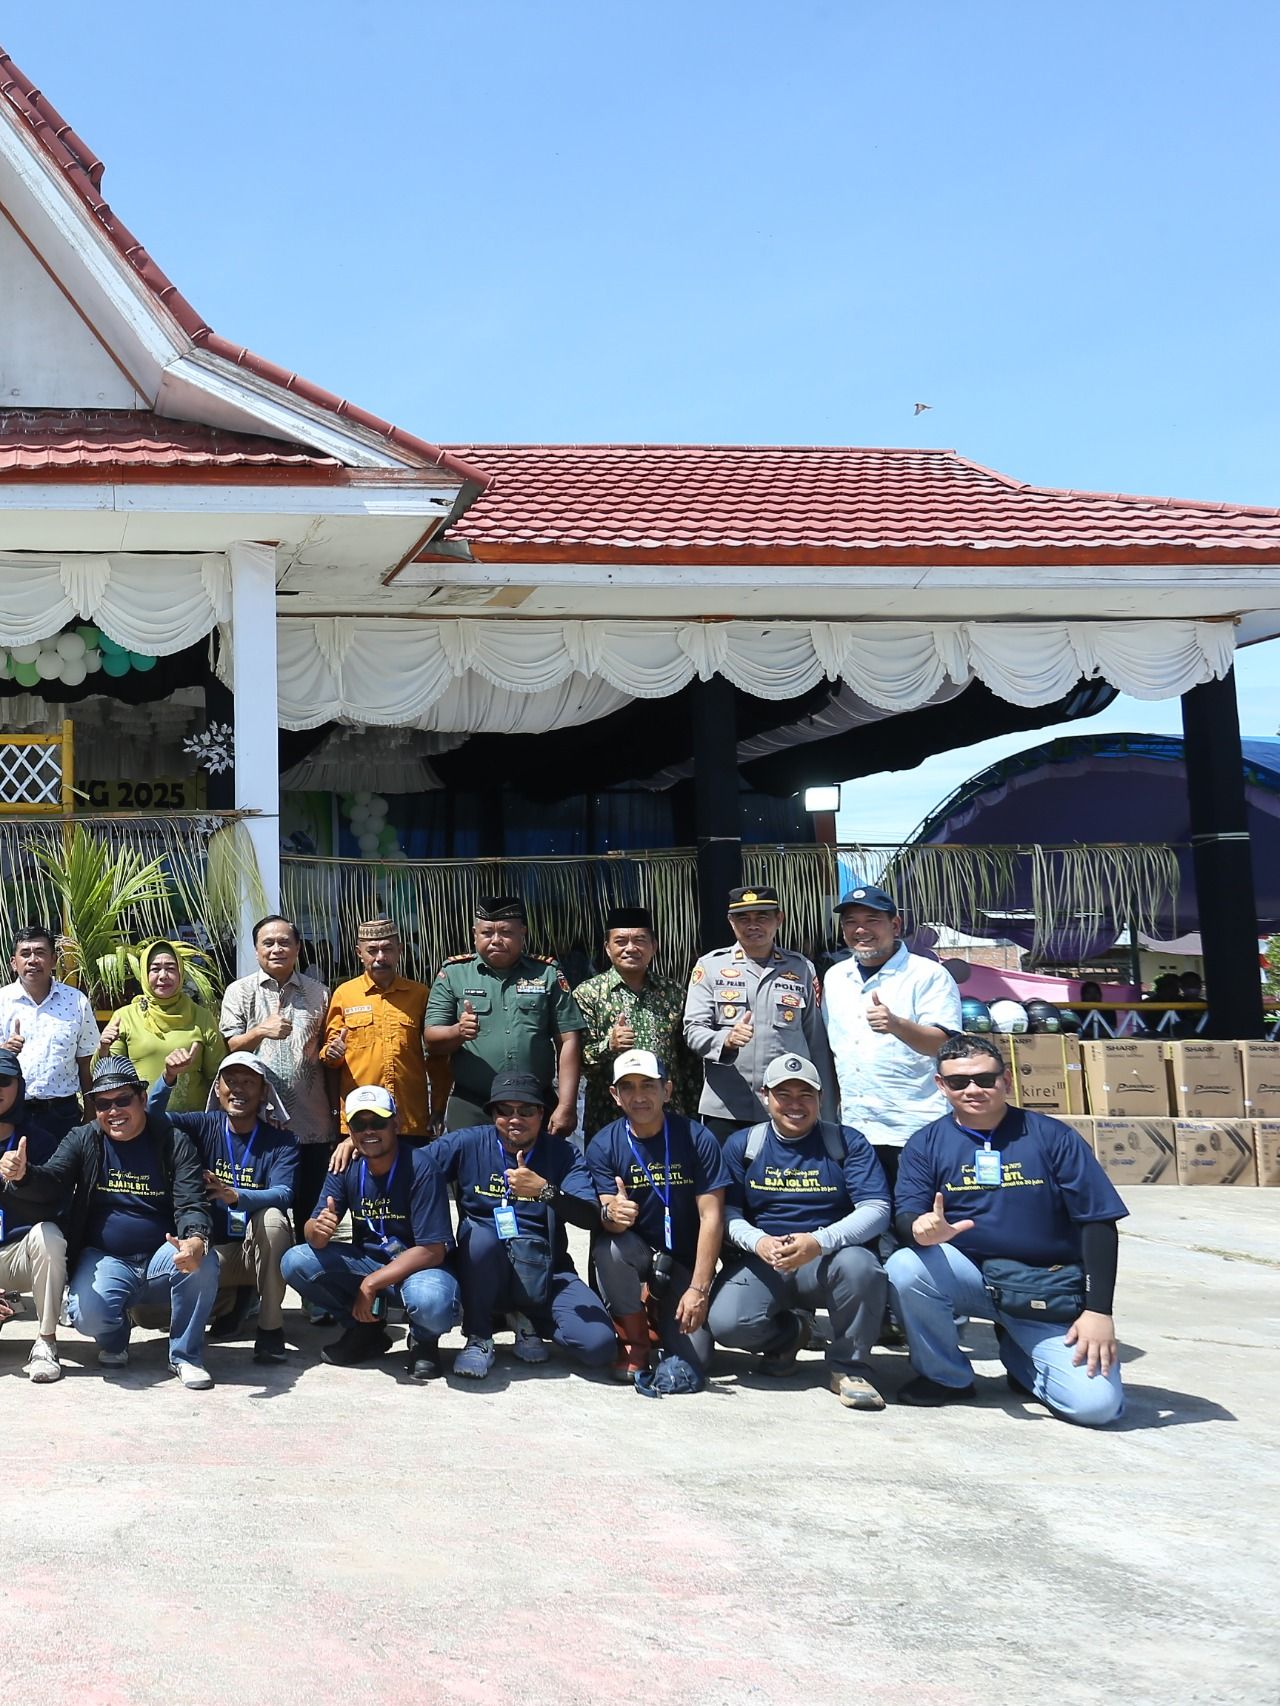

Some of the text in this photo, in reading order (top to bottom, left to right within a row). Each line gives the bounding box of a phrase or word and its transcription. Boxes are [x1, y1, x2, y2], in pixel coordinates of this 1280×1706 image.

[117, 782, 185, 808] 2025
[775, 983, 805, 994] POLRI
[1021, 1085, 1056, 1097] kirei
[240, 1174, 253, 1183] BTL
[764, 1177, 822, 1188] BJA IGL BTL
[963, 1170, 1024, 1186] BJ BTL
[108, 1179, 124, 1189] BJA
[135, 1182, 150, 1191] BTL
[489, 1184, 507, 1194] BJA
